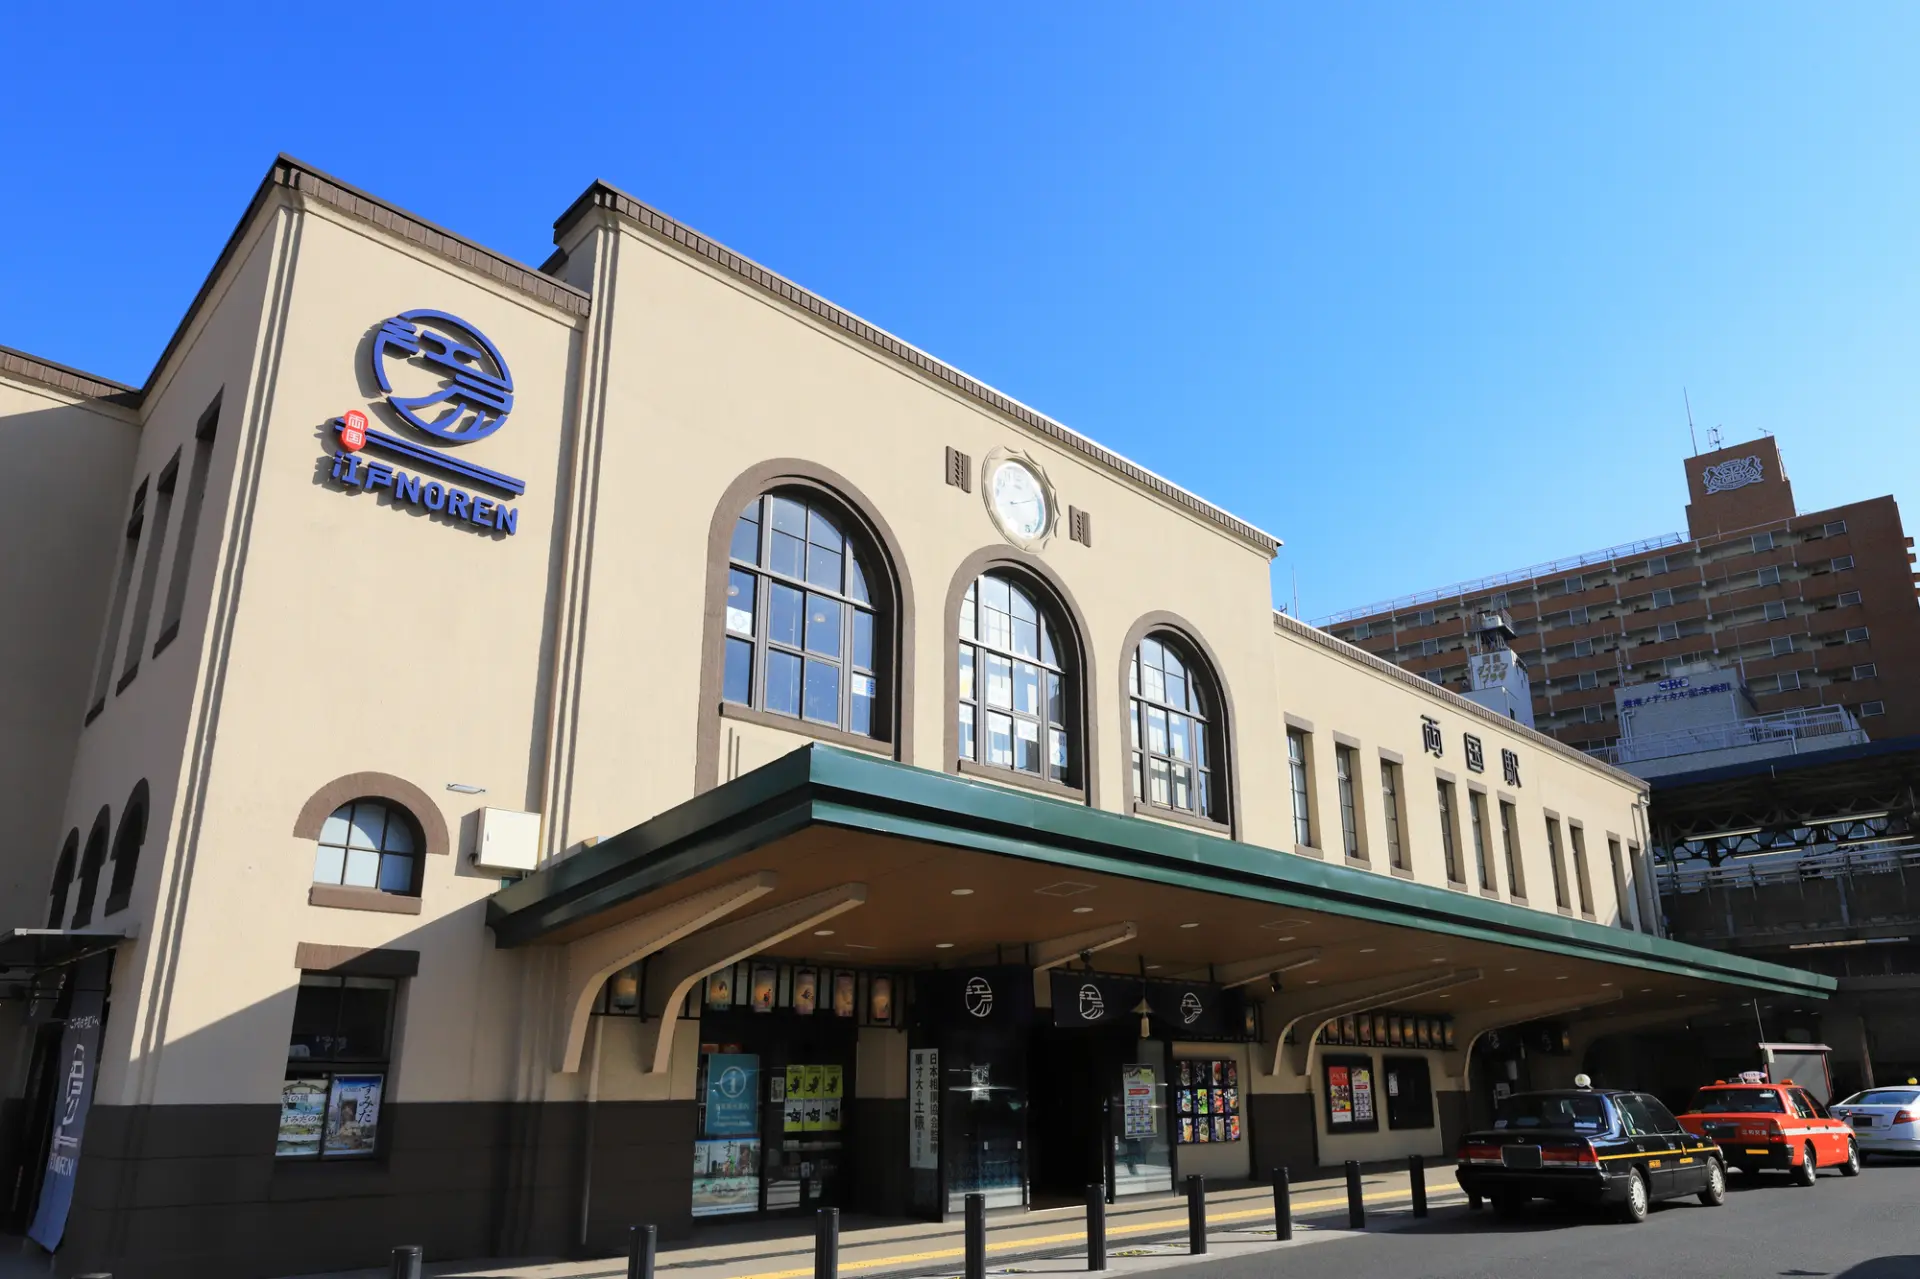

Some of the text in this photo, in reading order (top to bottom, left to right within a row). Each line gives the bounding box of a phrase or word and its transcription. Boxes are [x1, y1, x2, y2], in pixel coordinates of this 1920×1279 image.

[332, 450, 519, 535] 江戸NOREN
[1659, 677, 1690, 691] SBC
[1420, 714, 1522, 789] 両国駅
